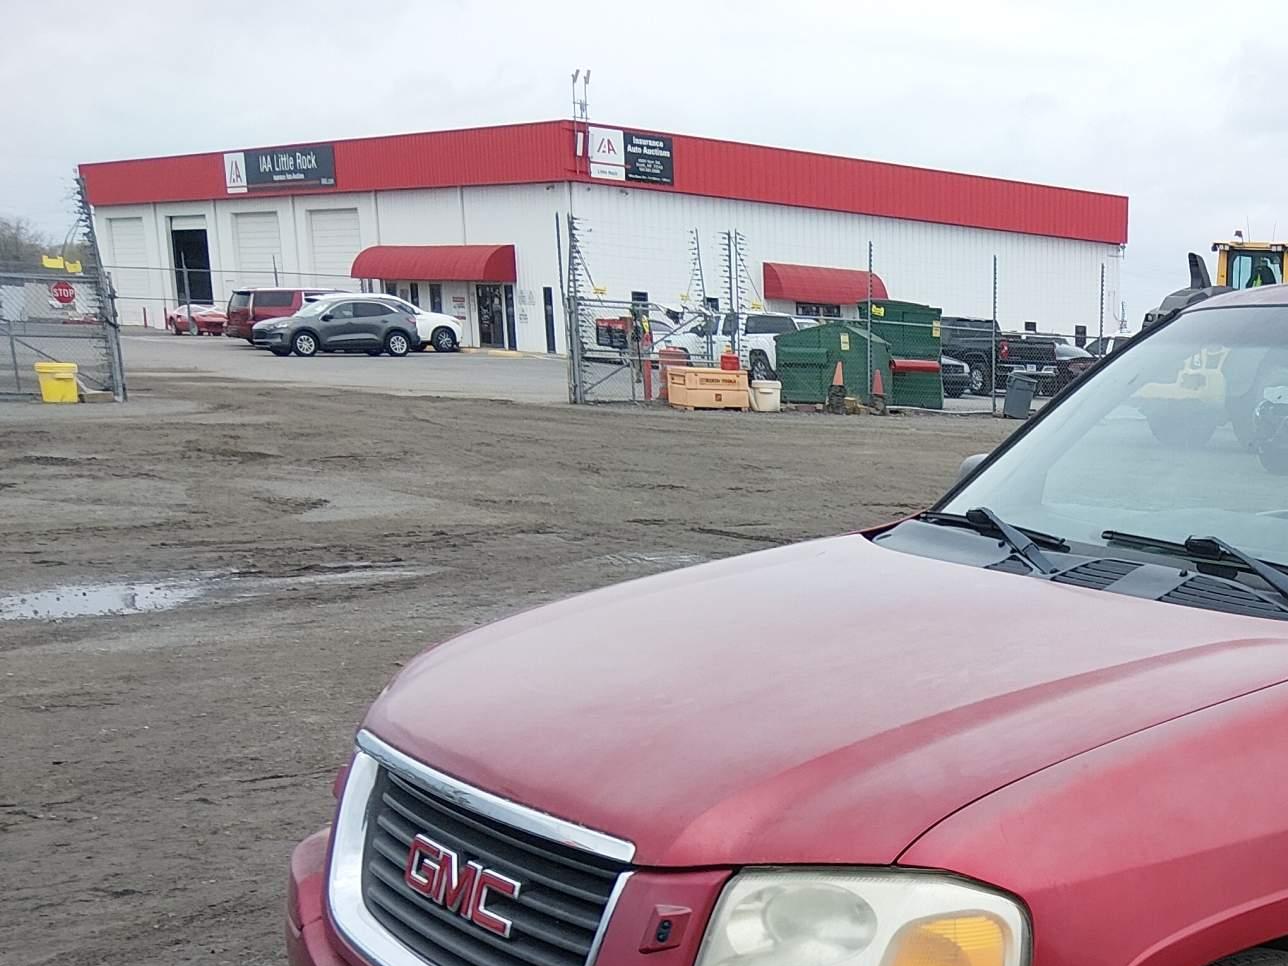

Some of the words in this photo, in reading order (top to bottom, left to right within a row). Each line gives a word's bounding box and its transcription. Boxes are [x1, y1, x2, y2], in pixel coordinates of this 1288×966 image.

[632, 136, 664, 148] Insurance
[627, 144, 642, 154] Auto
[643, 146, 670, 158] Auctions
[259, 155, 273, 173] IAA
[273, 153, 294, 171] Little
[296, 151, 318, 169] Rock
[53, 288, 74, 298] STOP
[405, 833, 521, 938] GMC
